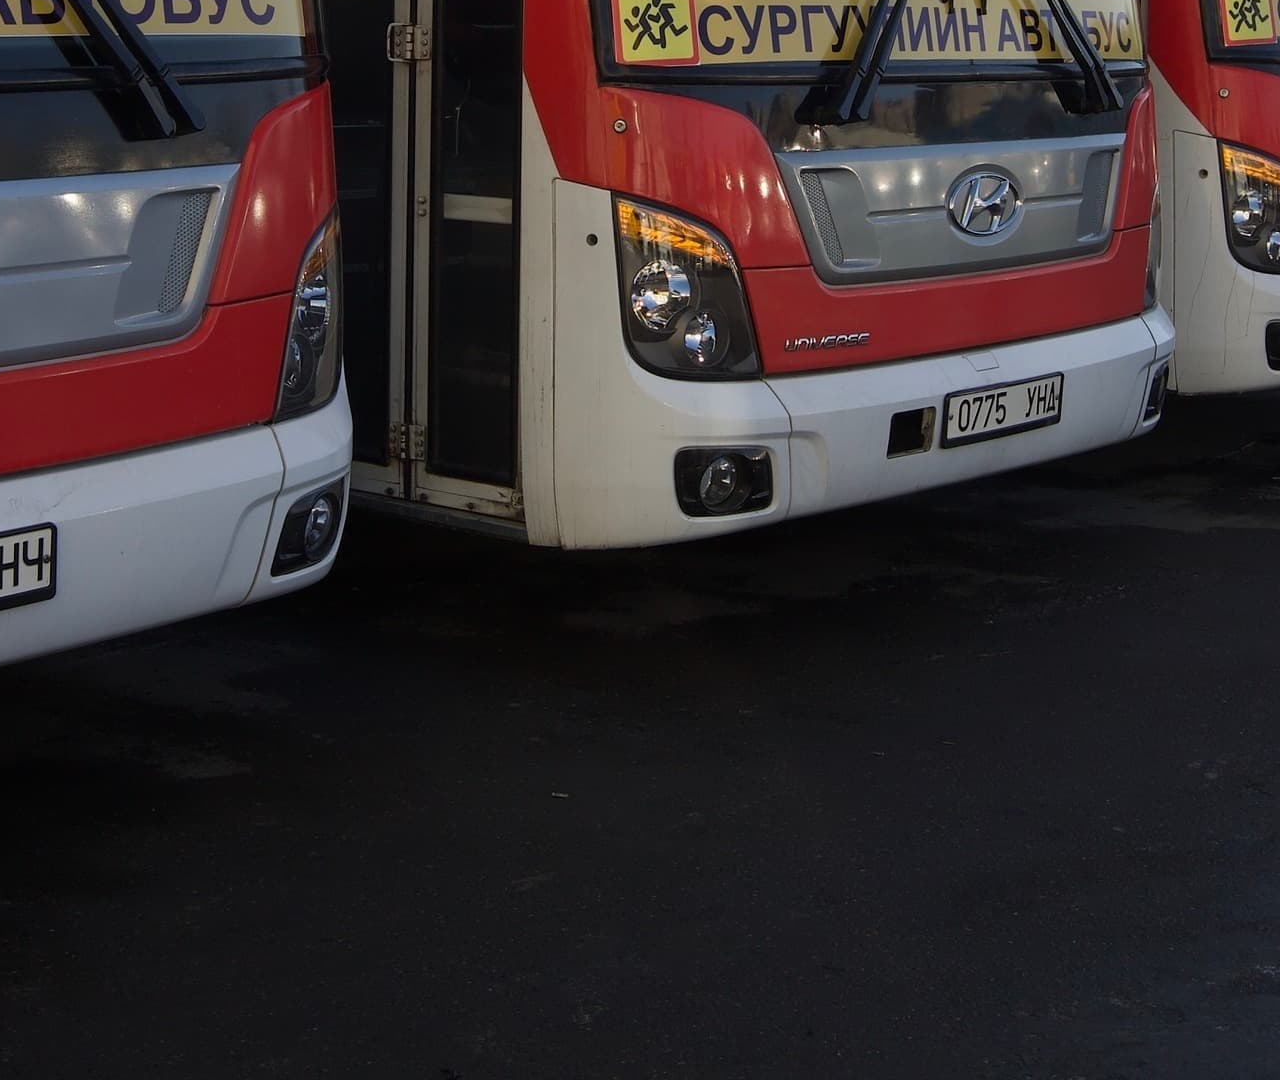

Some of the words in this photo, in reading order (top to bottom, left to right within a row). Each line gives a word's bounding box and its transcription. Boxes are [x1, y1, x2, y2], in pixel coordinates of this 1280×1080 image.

[997, 8, 1132, 53] АВТБУС
[784, 331, 870, 352] UNIVERSE
[957, 391, 1008, 432] 0775
